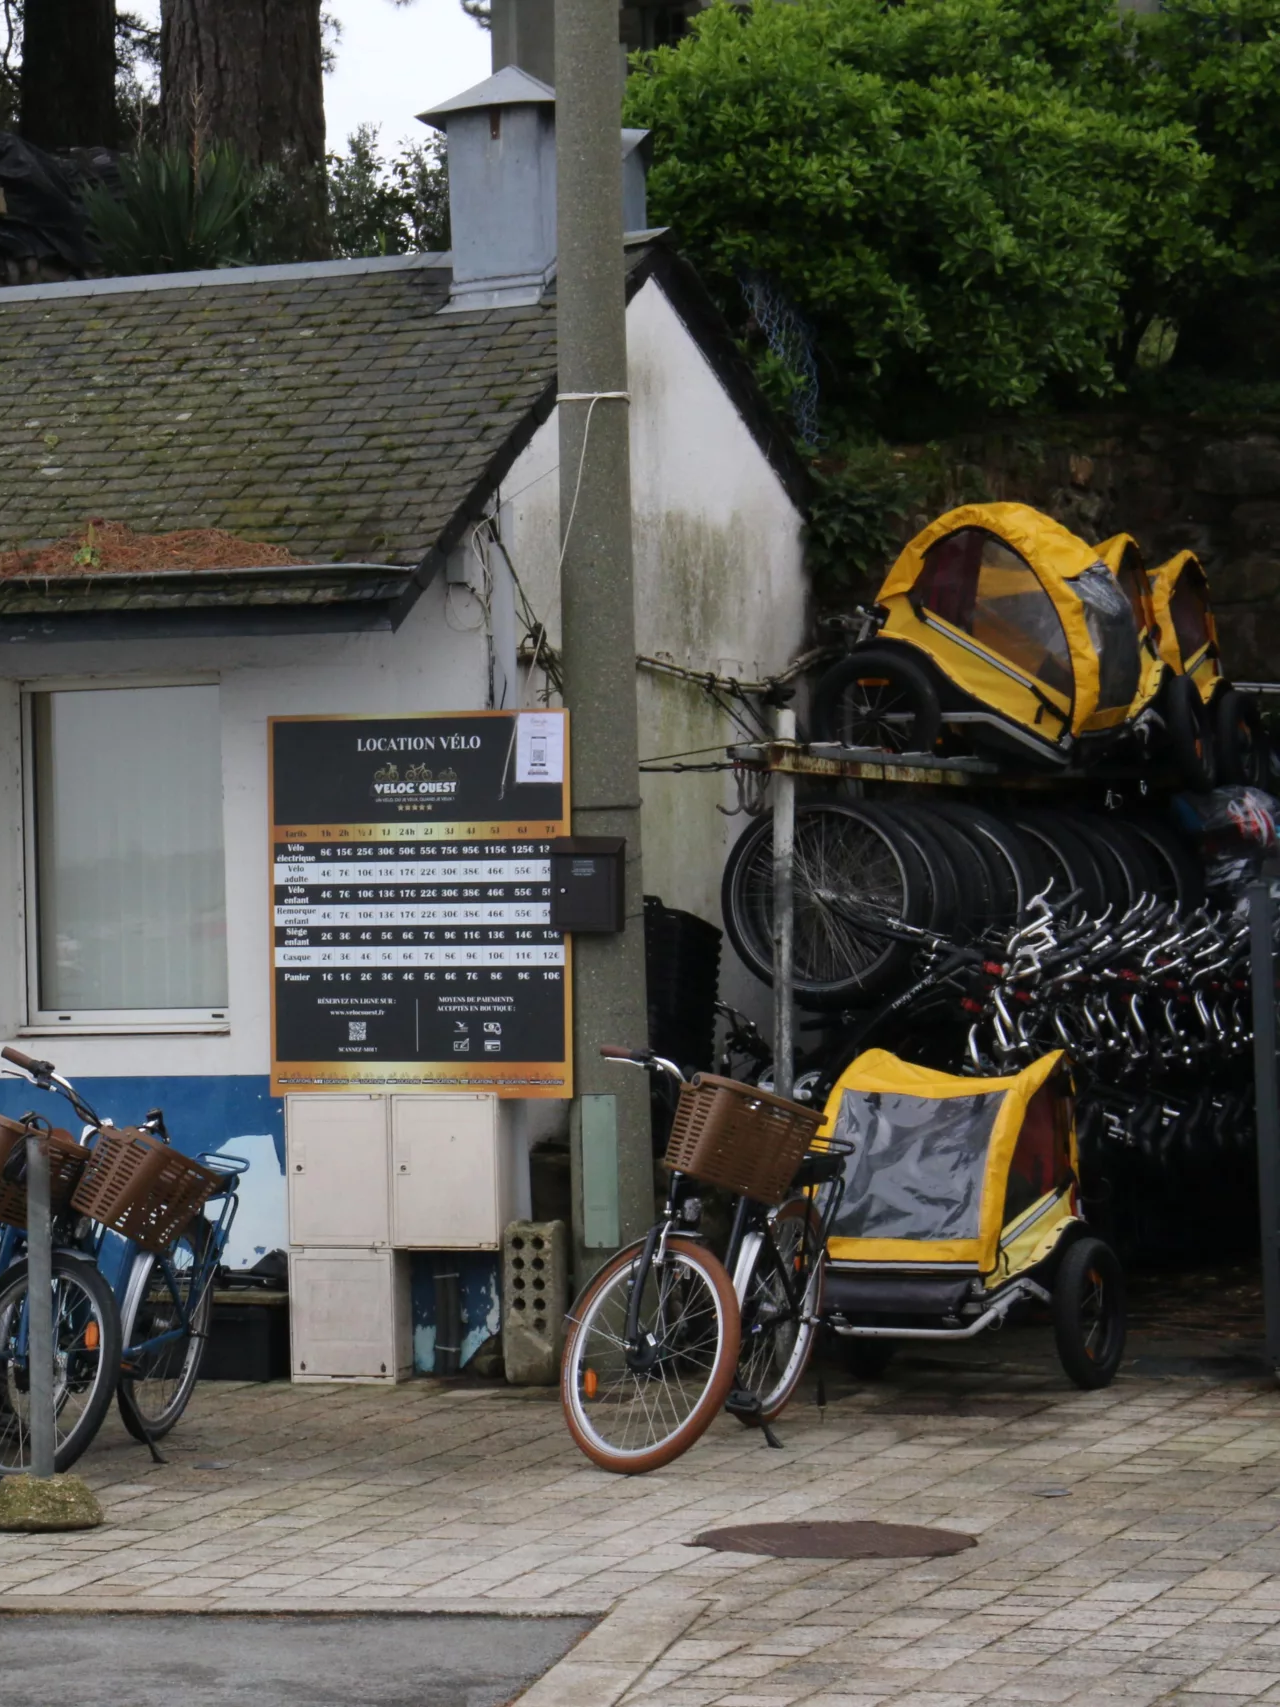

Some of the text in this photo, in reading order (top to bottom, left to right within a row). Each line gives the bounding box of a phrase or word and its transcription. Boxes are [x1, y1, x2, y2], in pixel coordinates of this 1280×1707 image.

[356, 733, 481, 752] LOCATION VÉLO
[382, 828, 391, 836] 1J
[399, 828, 415, 836] 24h
[490, 826, 499, 834] 5J
[546, 826, 554, 834] 7J
[287, 844, 304, 852] Vélo
[320, 848, 332, 856] 8€
[336, 848, 353, 856] 15€
[357, 848, 373, 856] 25€
[399, 847, 416, 855] 50€
[420, 847, 437, 855] 55€
[441, 846, 458, 854] 75€
[462, 846, 479, 854] 95€
[484, 846, 507, 854] 115€
[512, 845, 534, 853] 125€
[539, 845, 550, 853] 13
[277, 854, 316, 863] électrique
[287, 865, 304, 873] Vélo
[420, 868, 436, 876] 22€
[487, 867, 504, 875] 46€
[288, 886, 305, 894] Vélo
[358, 890, 374, 898] 10€
[378, 890, 395, 898] 13€
[420, 889, 437, 897] 22€
[441, 889, 458, 897] 30€
[462, 889, 480, 897] 38€
[514, 888, 532, 896] 55€
[277, 907, 316, 916] Remorque
[463, 910, 480, 918] 38€
[286, 927, 308, 936] Siège
[321, 932, 333, 940] 2€
[339, 932, 351, 940] 3€
[360, 932, 372, 940] 4€
[423, 931, 435, 939] 7€
[444, 931, 456, 939] 9€
[463, 931, 480, 939] 11€
[488, 931, 505, 939] 13€
[515, 931, 532, 939] 14€
[542, 930, 560, 938] 15€
[284, 938, 310, 946] enfant
[283, 953, 311, 962] Casque
[424, 952, 435, 960] 7€
[543, 951, 559, 959] 12€
[284, 973, 310, 981] Panier
[322, 973, 333, 981] 1€
[340, 973, 351, 981] 1€
[361, 973, 372, 981] 2€
[381, 973, 393, 981] 3€
[444, 972, 457, 980] 6€
[466, 972, 478, 980] 7€
[490, 972, 503, 980] 8€
[518, 972, 530, 980] 9€
[543, 972, 560, 980] 10€
